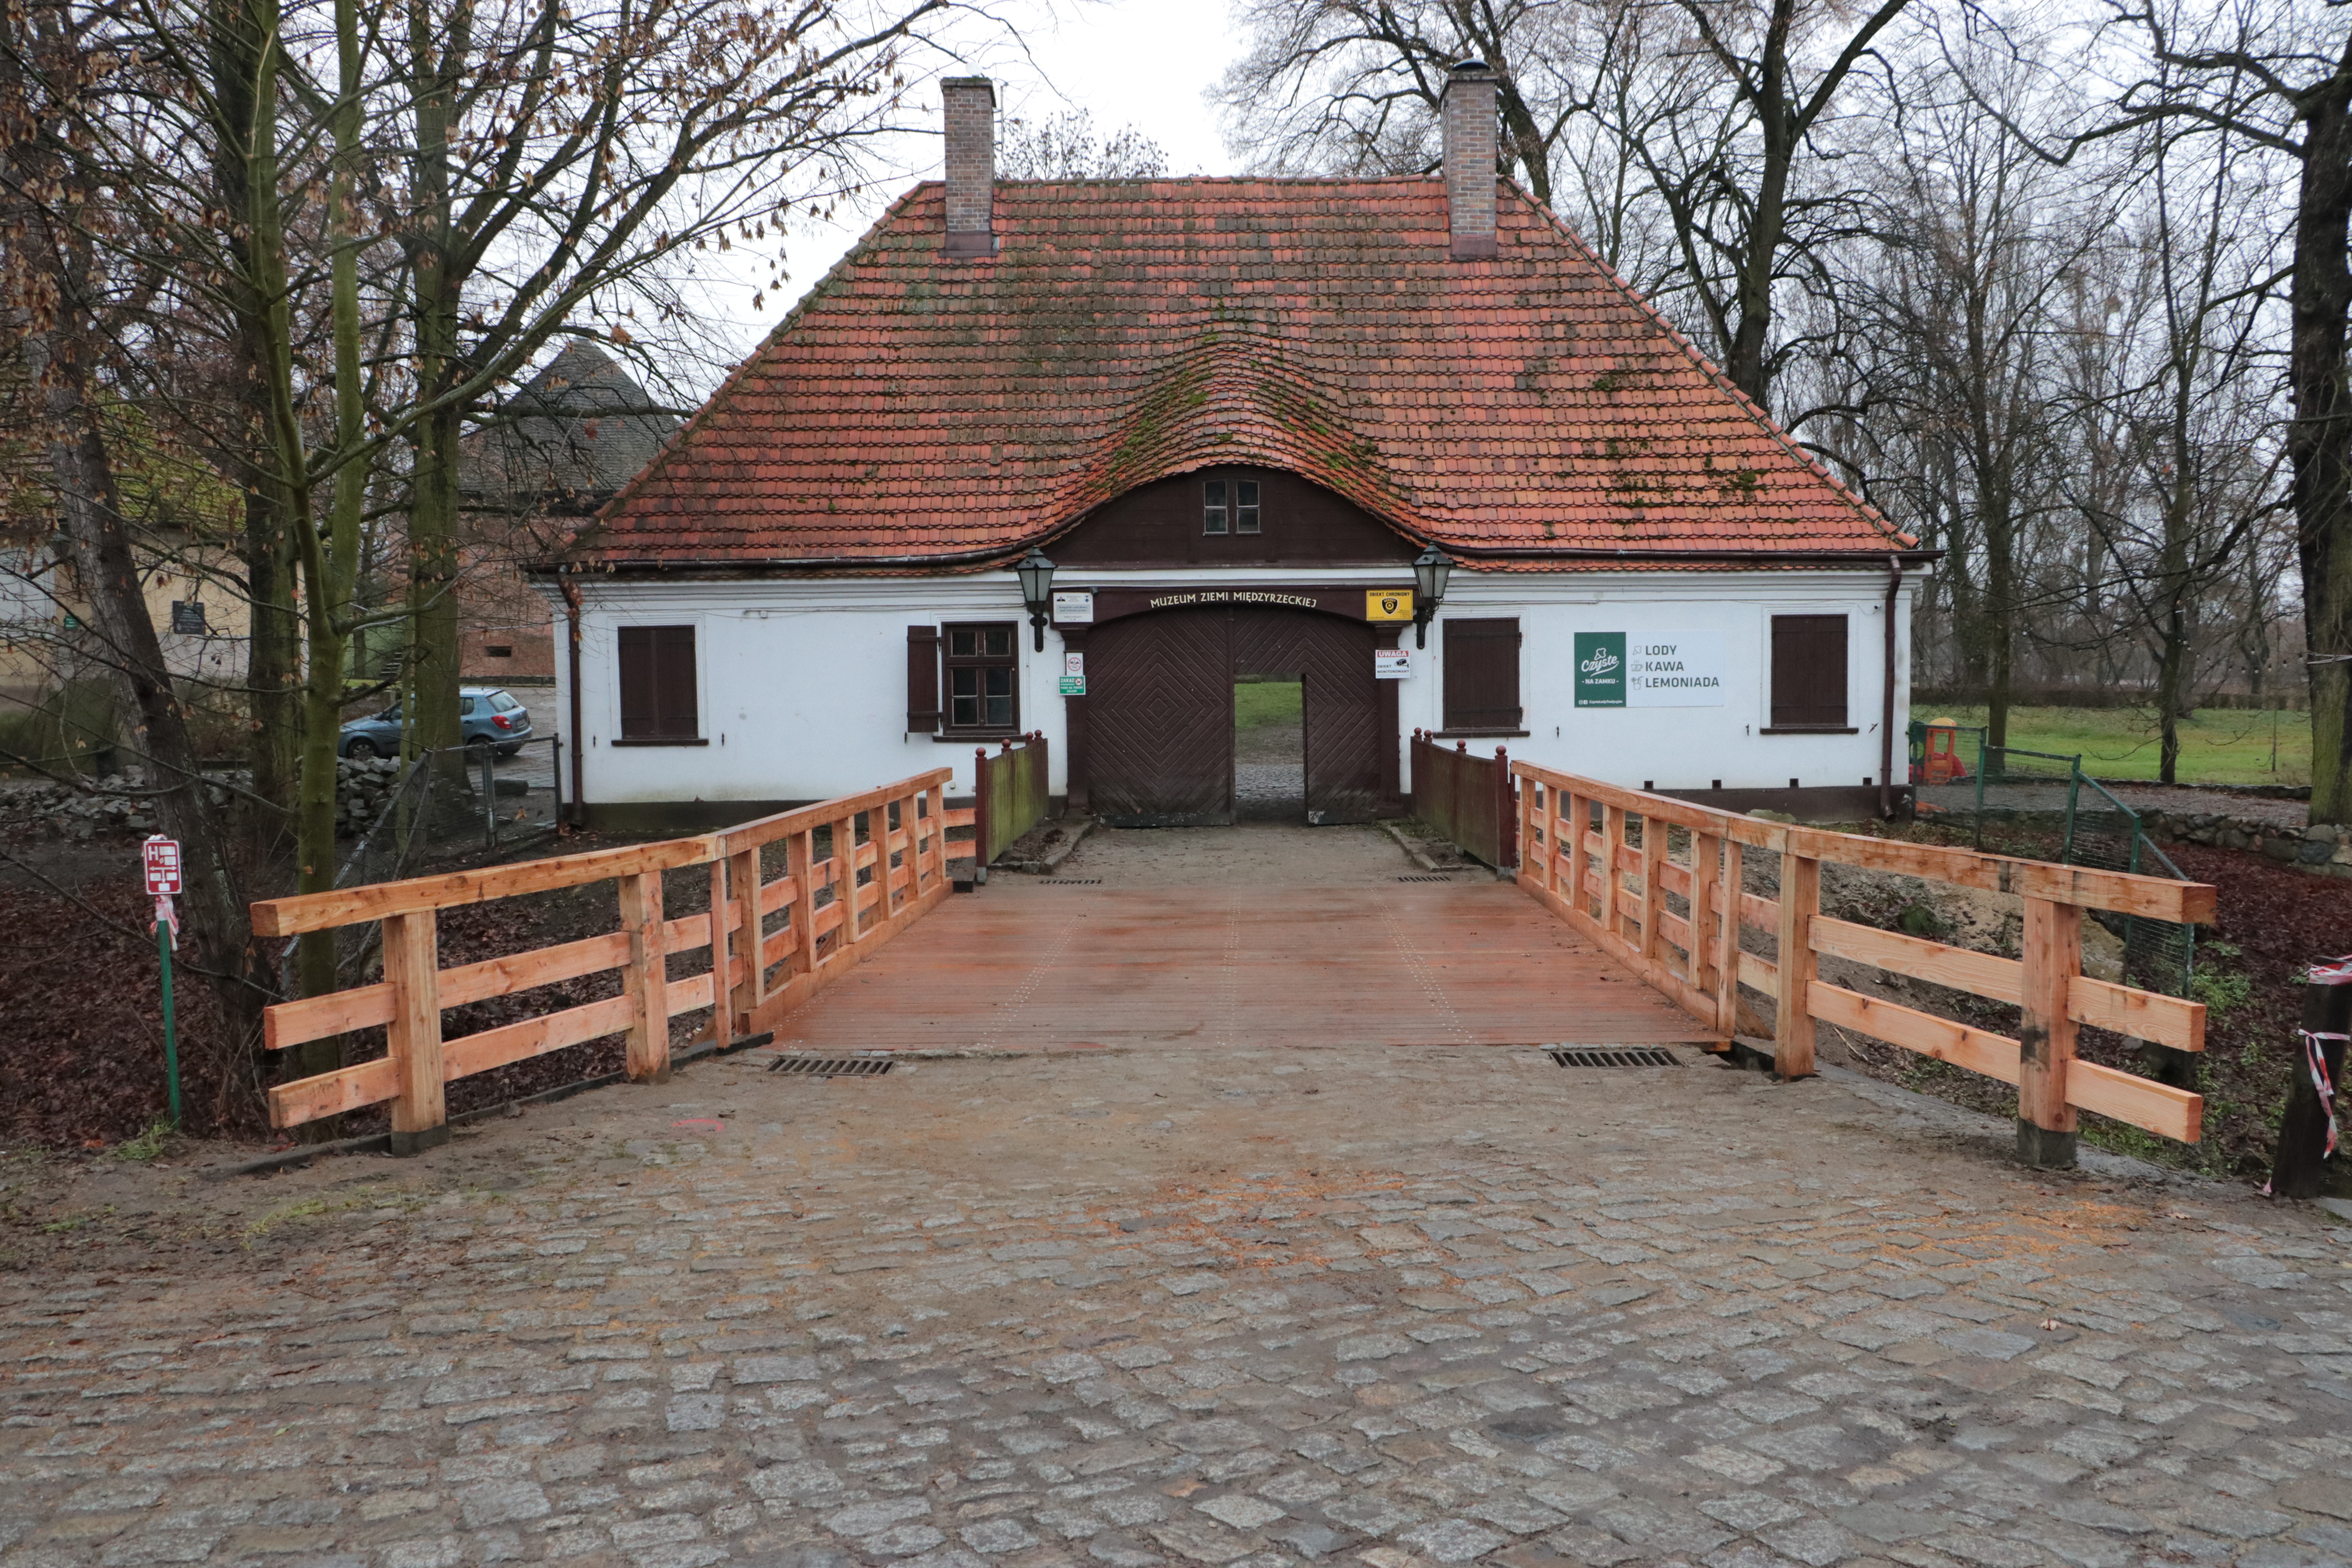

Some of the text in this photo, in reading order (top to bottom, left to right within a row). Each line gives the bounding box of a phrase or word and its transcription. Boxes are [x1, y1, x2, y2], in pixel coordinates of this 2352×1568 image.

[1150, 592, 1317, 608] MUZEUM ZIEMI MIĘDZYRZECKIEJ
[1646, 645, 1677, 655] LODY
[1581, 655, 1619, 672] Czyste
[1646, 661, 1684, 671] KAWA
[1646, 677, 1719, 688] LEMONIADA
[148, 846, 158, 860] H
